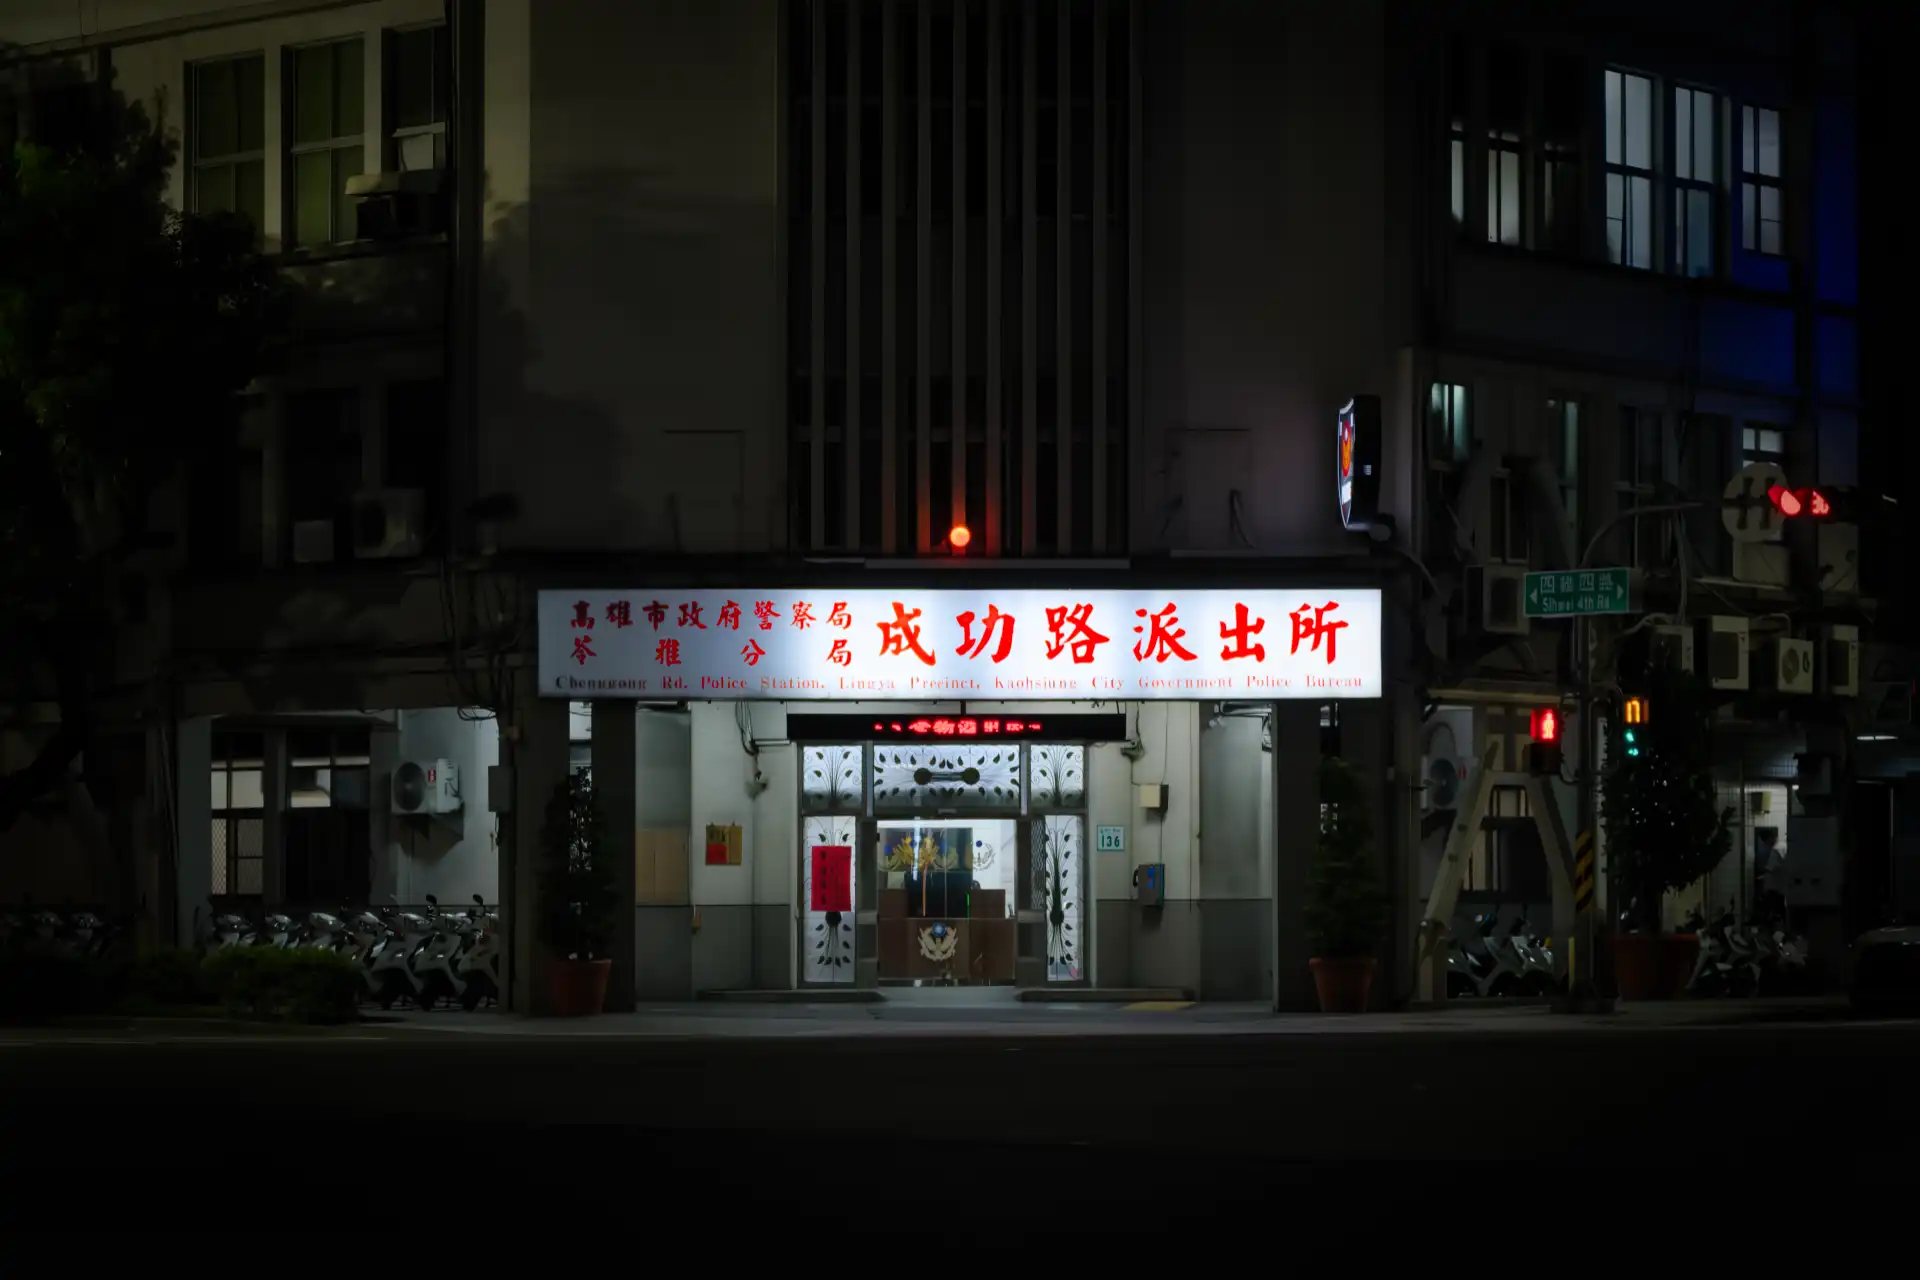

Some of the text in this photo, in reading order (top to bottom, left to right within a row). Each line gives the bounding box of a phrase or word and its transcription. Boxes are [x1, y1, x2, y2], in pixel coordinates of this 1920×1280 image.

[570, 600, 853, 631] 高雄市政府警察局
[877, 601, 1349, 667] 成功路派出所
[570, 636, 853, 668] 苓雅分局
[662, 675, 689, 690] Rd.
[701, 675, 748, 690] Police
[1092, 675, 1124, 692] City
[1138, 675, 1233, 690] Government
[1247, 675, 1291, 690] Police
[1306, 675, 1363, 690] Bureau
[1101, 835, 1120, 848] 136
